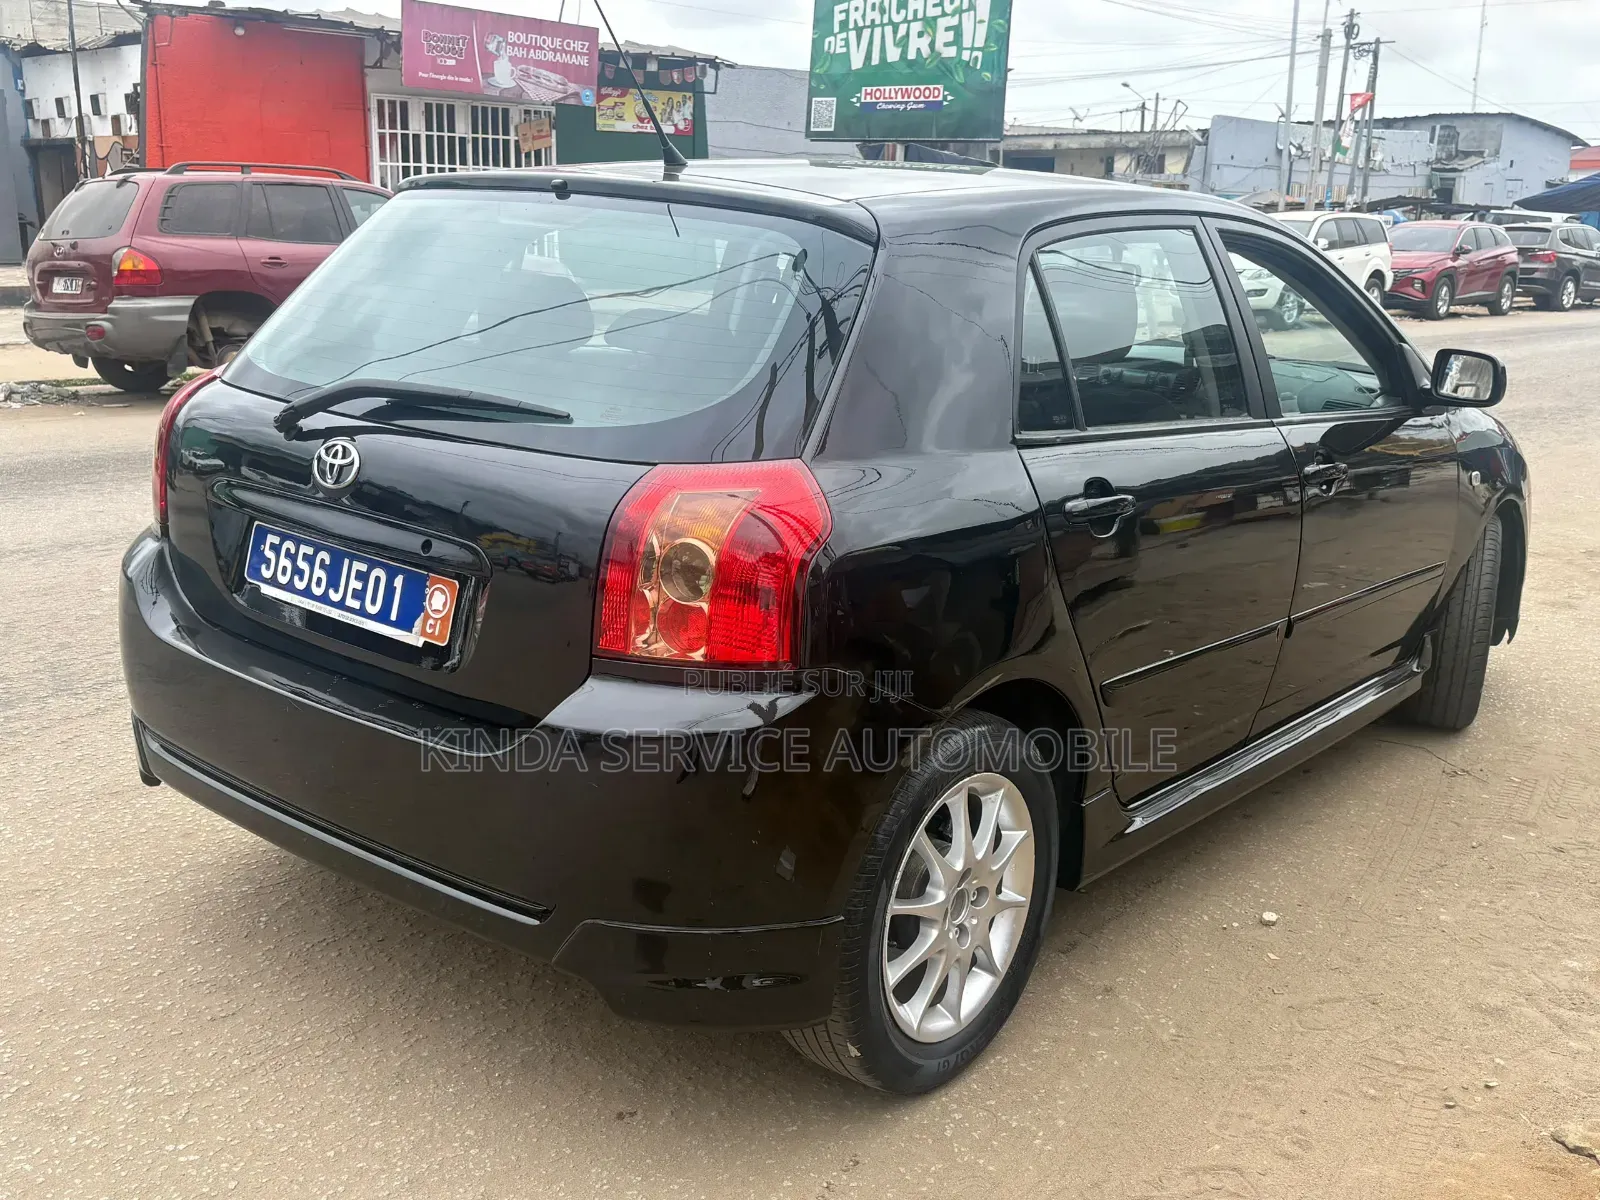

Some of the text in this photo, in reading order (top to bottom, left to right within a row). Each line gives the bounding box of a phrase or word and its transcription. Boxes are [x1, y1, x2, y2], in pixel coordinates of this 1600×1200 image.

[422, 29, 468, 48] BONNET
[507, 30, 590, 53] BOUTIQUE CHEZ
[824, 32, 848, 55] DE
[425, 41, 465, 59] ROUGE
[506, 45, 590, 67] BAH ABDRAMANE
[863, 86, 941, 101] HOLLYWOOD
[632, 123, 648, 131] chez
[426, 618, 441, 636] CI
